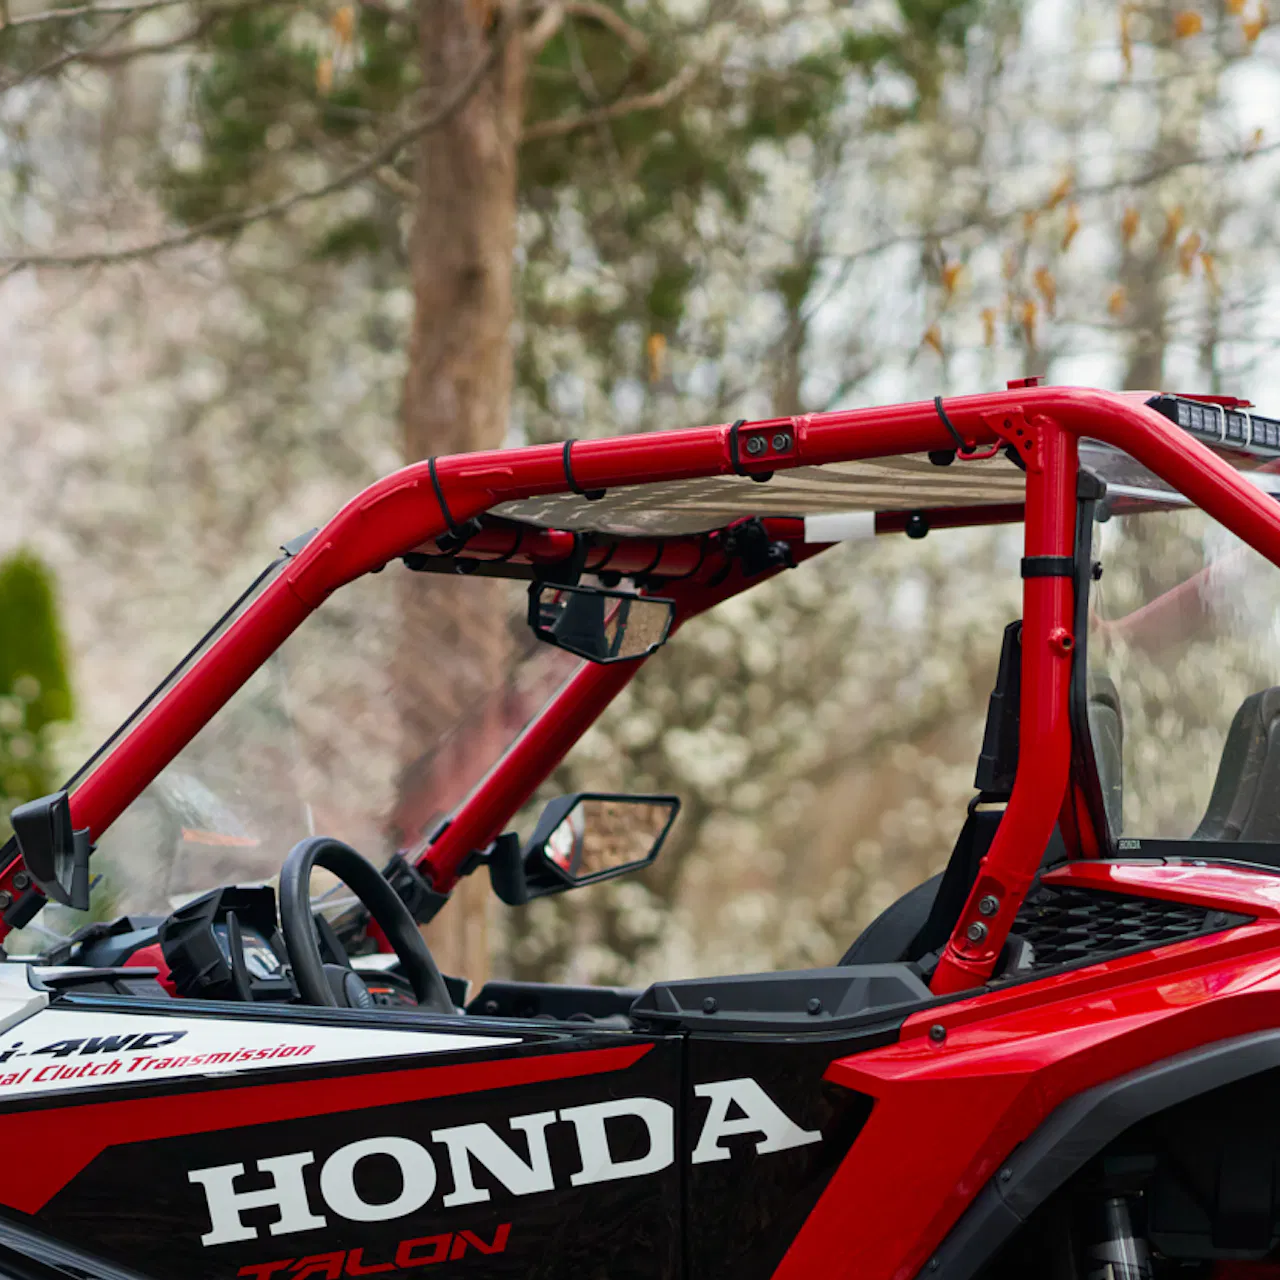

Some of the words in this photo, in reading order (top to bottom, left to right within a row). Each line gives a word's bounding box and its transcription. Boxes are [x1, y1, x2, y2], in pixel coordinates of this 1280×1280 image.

[33, 1059, 122, 1083] Clutch
[127, 1043, 316, 1073] Transmission
[187, 1077, 823, 1247] HONDA
